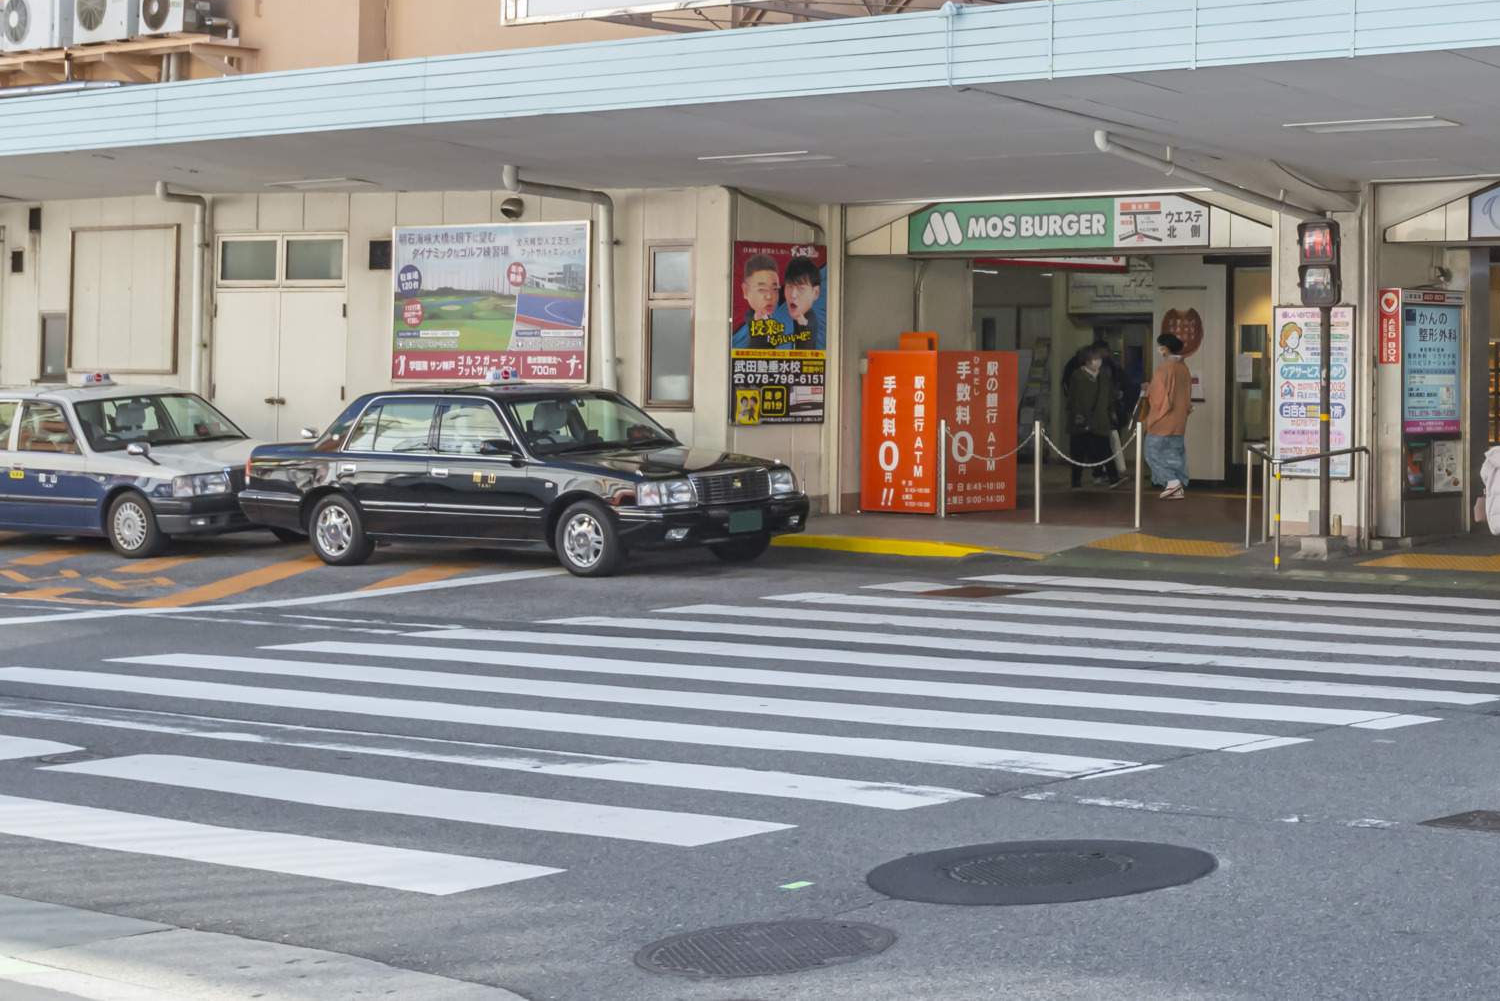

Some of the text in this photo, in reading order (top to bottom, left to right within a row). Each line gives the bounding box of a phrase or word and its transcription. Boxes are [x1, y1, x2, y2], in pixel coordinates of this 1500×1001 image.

[1165, 210, 1203, 224] ウエステ
[967, 212, 1106, 239] MOS BURGER
[412, 245, 509, 260] ダイナミックなゴルフ練習場
[401, 281, 419, 290] 120台
[1419, 311, 1448, 325] かんの
[1388, 318, 1396, 362] AED BOX
[1419, 328, 1457, 342] 整形外科
[430, 359, 456, 371] サン神戸
[457, 355, 516, 366] ゴルフガーデン
[734, 360, 801, 373] 武田塾垂水校
[531, 365, 557, 376] 700m
[747, 373, 824, 384] 078-798-6151
[764, 401, 783, 410] 約1分
[986, 361, 999, 472] 駅の銀行 ATM
[914, 376, 925, 478] 駅の銀行 ATM
